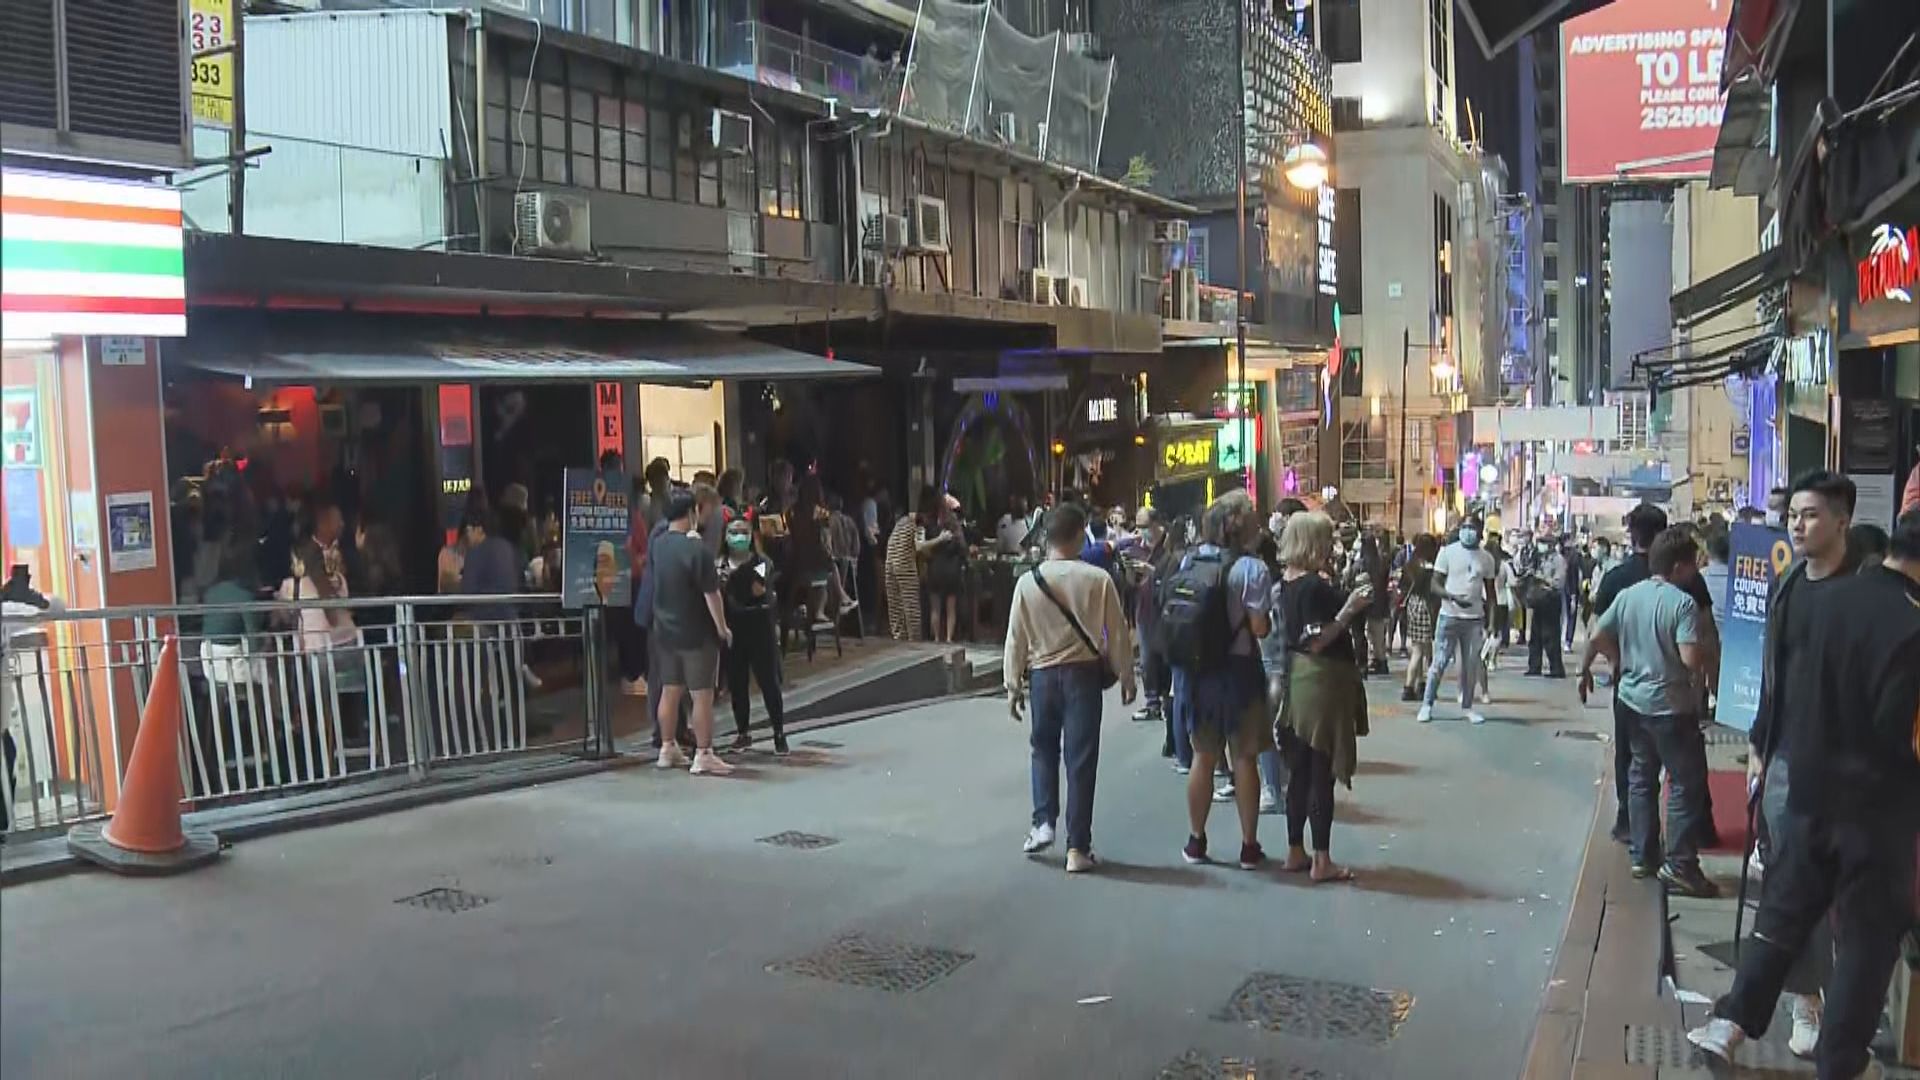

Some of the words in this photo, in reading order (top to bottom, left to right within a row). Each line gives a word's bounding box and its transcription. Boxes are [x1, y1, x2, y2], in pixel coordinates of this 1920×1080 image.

[1570, 30, 1686, 54] ADVERTISING
[1690, 28, 1727, 47] SPA
[1636, 51, 1679, 87] TO
[1640, 88, 1687, 105] PLEASE
[1735, 555, 1769, 581] FREE
[1733, 577, 1769, 598] COUPON
